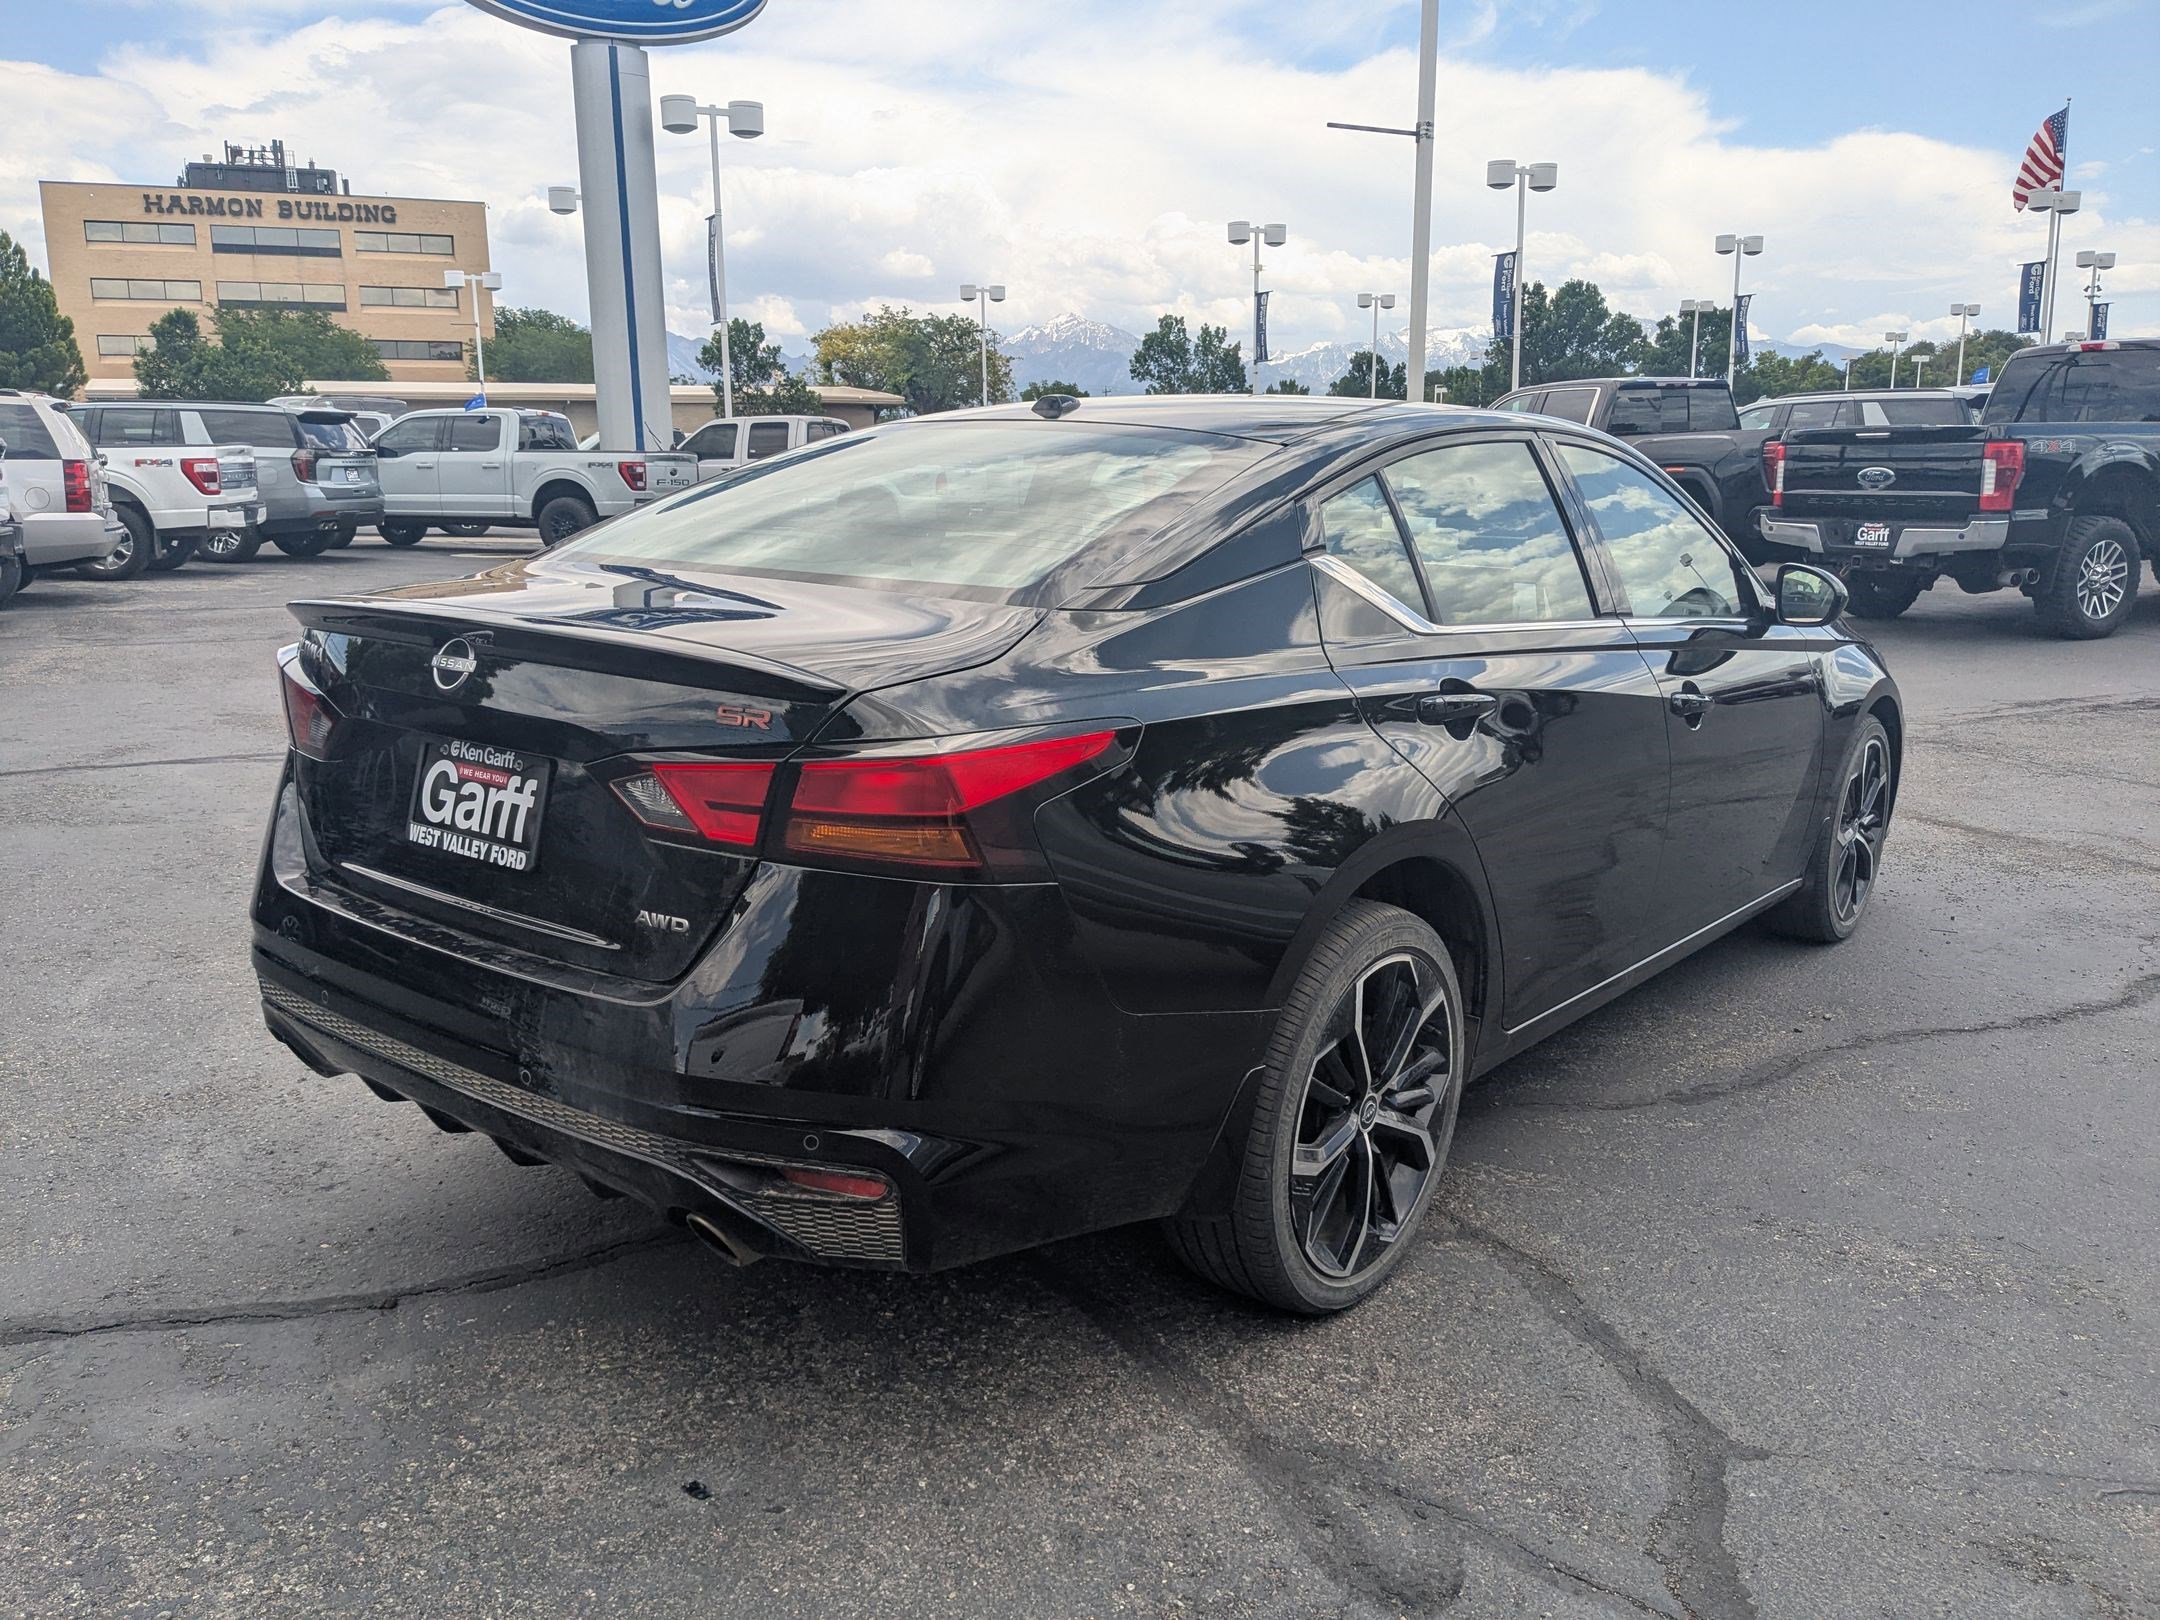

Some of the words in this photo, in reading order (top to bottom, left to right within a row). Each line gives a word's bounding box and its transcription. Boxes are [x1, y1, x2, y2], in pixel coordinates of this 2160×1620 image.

[143, 194, 263, 217] HARMON
[277, 199, 397, 224] BUILDING
[2028, 276, 2036, 295] Ford
[135, 458, 173, 467] FX4
[1857, 526, 1890, 542] Garff
[433, 655, 477, 673] NISSAN
[716, 705, 772, 730] SR
[460, 741, 484, 762] Ken
[484, 747, 516, 769] Garff
[463, 767, 473, 776] WE
[474, 770, 491, 780] HEAR
[492, 774, 504, 783] YOU
[422, 759, 538, 843] Garff
[409, 823, 442, 848] WEST
[442, 832, 490, 861] VALLEY
[490, 844, 527, 870] FORD
[634, 909, 690, 933] AWD
